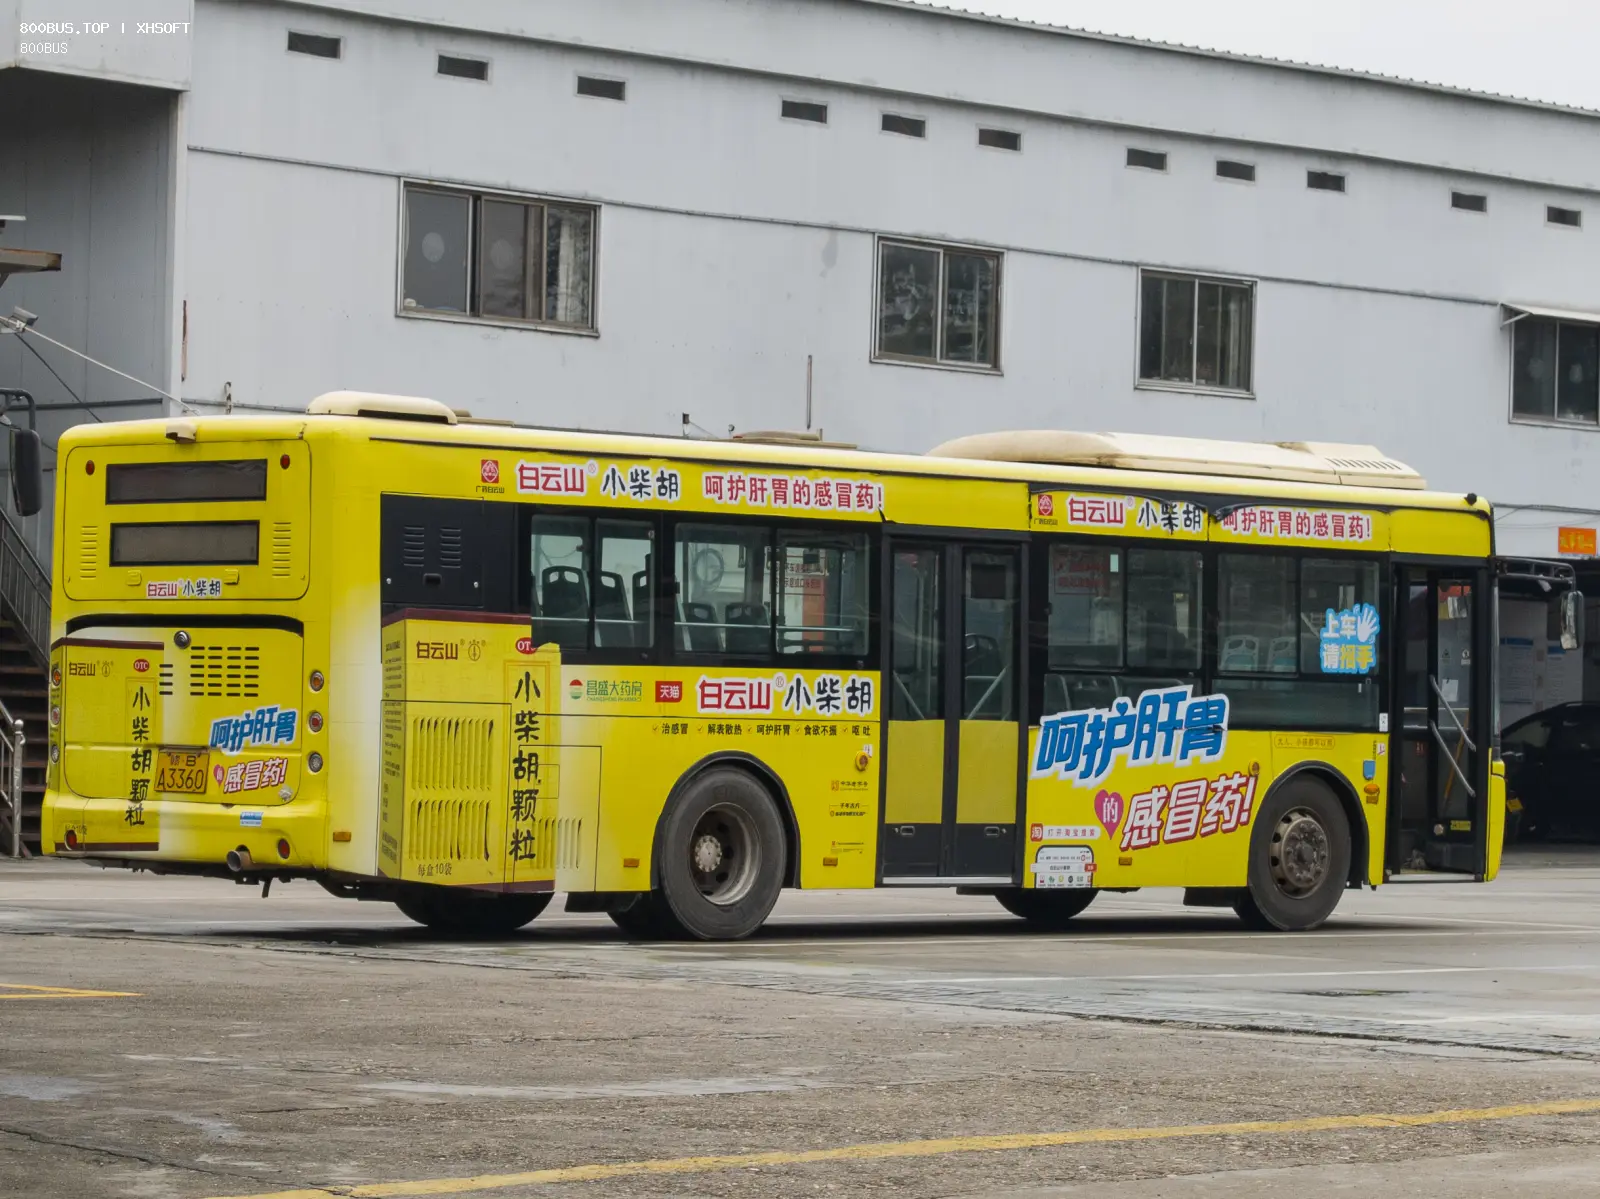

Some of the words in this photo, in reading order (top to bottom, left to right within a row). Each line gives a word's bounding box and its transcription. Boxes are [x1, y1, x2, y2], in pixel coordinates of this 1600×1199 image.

[518, 464, 585, 493] 白云山
[602, 467, 679, 500] 小柴胡
[1068, 497, 1124, 524] 白云山
[147, 583, 178, 597] 白云山
[182, 580, 221, 597] 小柴胡
[1322, 613, 1357, 640] 上车
[415, 641, 459, 660] 白云山
[517, 640, 536, 652] OT
[1323, 643, 1374, 669] 请招手
[68, 662, 96, 677] 白云山
[134, 660, 149, 671] OTC
[586, 680, 643, 697] 昌盛大药房
[659, 684, 680, 699] 天猫
[699, 679, 771, 710] 白云山
[785, 677, 872, 713] 小柴胡
[210, 706, 297, 752] 呵护肝胃
[661, 722, 689, 735] 治感冒
[707, 723, 742, 735] 解表散热
[756, 723, 791, 736] 呵护肝胃
[804, 724, 838, 736] 食欲不振
[1036, 690, 1227, 780] 呵护肝胃
[157, 768, 205, 790] A3360
[223, 757, 288, 794] 感冒药!
[508, 671, 541, 862] 小柴胡颗粒
[1102, 796, 1118, 824] 的
[1119, 772, 1258, 852] 感冒药!
